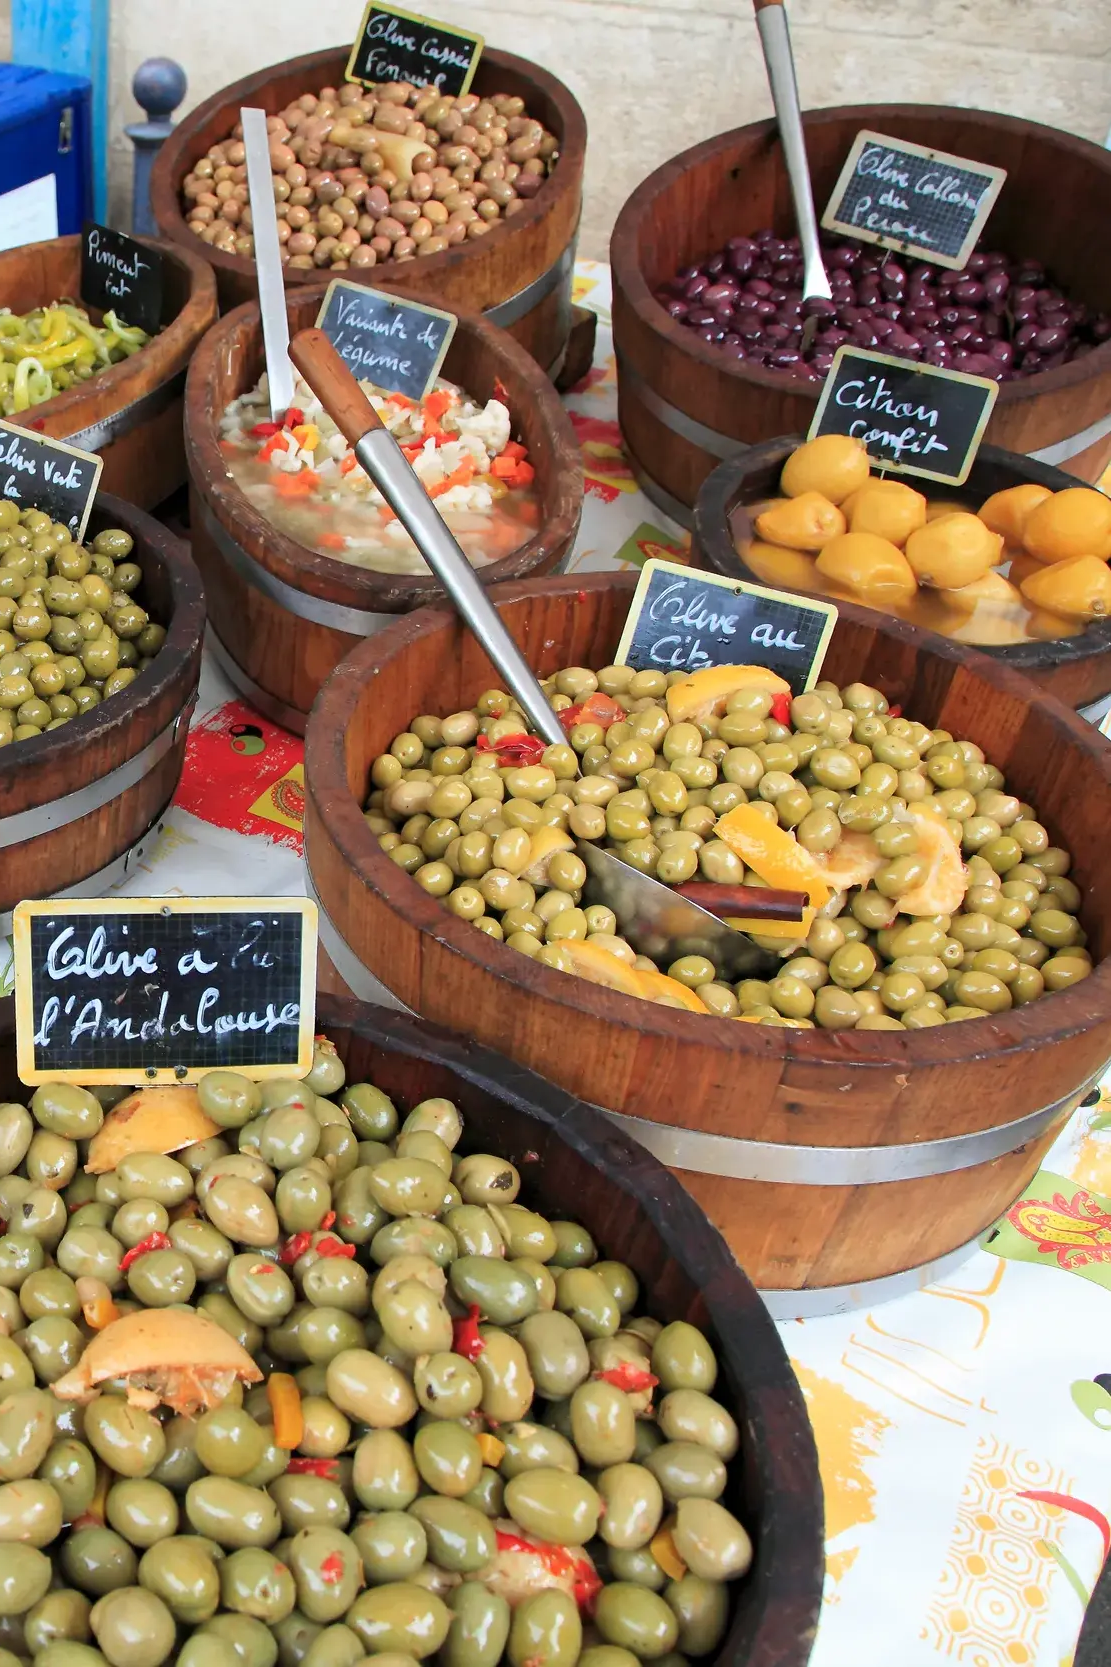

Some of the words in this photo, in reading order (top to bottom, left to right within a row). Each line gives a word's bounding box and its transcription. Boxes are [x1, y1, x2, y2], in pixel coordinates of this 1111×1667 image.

[367, 14, 416, 51] Olive
[857, 147, 910, 188] Olive
[879, 189, 910, 211] du
[88, 230, 151, 279] Piment
[417, 321, 439, 350] de
[835, 375, 939, 428] Citron
[4, 475, 22, 498] la
[649, 581, 739, 635] Olive
[750, 623, 806, 651] au
[45, 924, 159, 981] Olive
